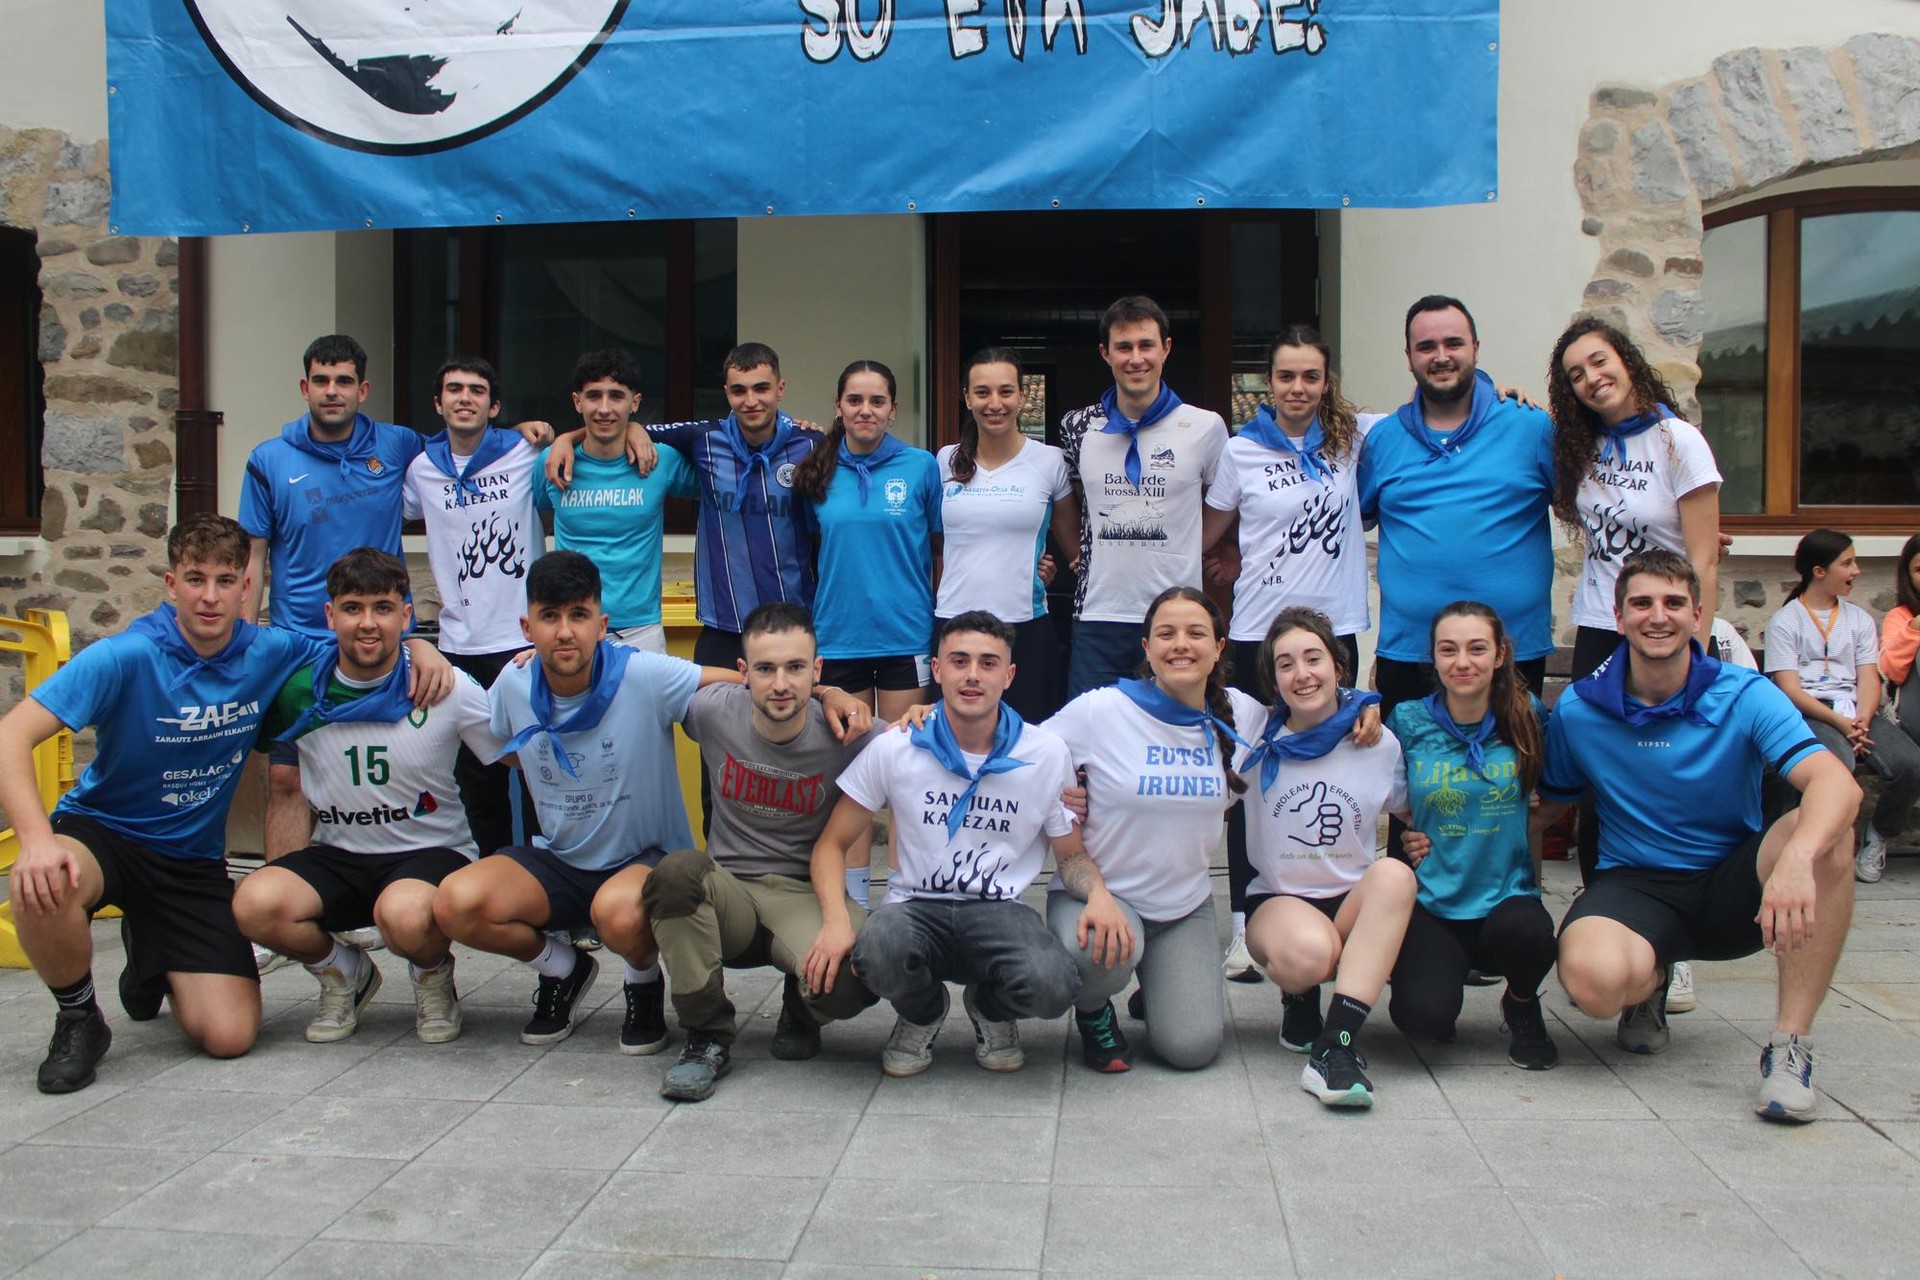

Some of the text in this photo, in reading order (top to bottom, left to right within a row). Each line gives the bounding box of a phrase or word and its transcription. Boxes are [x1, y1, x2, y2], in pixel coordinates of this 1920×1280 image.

[1264, 459, 1297, 477] SAN
[1267, 463, 1341, 492] KALEAR
[473, 474, 510, 489] UAN
[1104, 473, 1166, 486] Baxrde
[1588, 469, 1648, 491] KALEZAR
[560, 488, 644, 508] KAXKAMELAK
[1143, 487, 1165, 497] XIII
[154, 735, 192, 744] ZARAUTZ
[343, 745, 391, 787] 15
[1145, 745, 1215, 767] EUTSI
[721, 751, 825, 816] EVERLAST
[1414, 760, 1519, 788] Lilaon
[1136, 775, 1222, 797] IRUNE!
[309, 801, 411, 826] elvetia
[969, 795, 1019, 815] JUAN
[1271, 782, 1362, 834] KIROLEAN ERRESPETU
[922, 810, 1012, 833] KAEZAR
